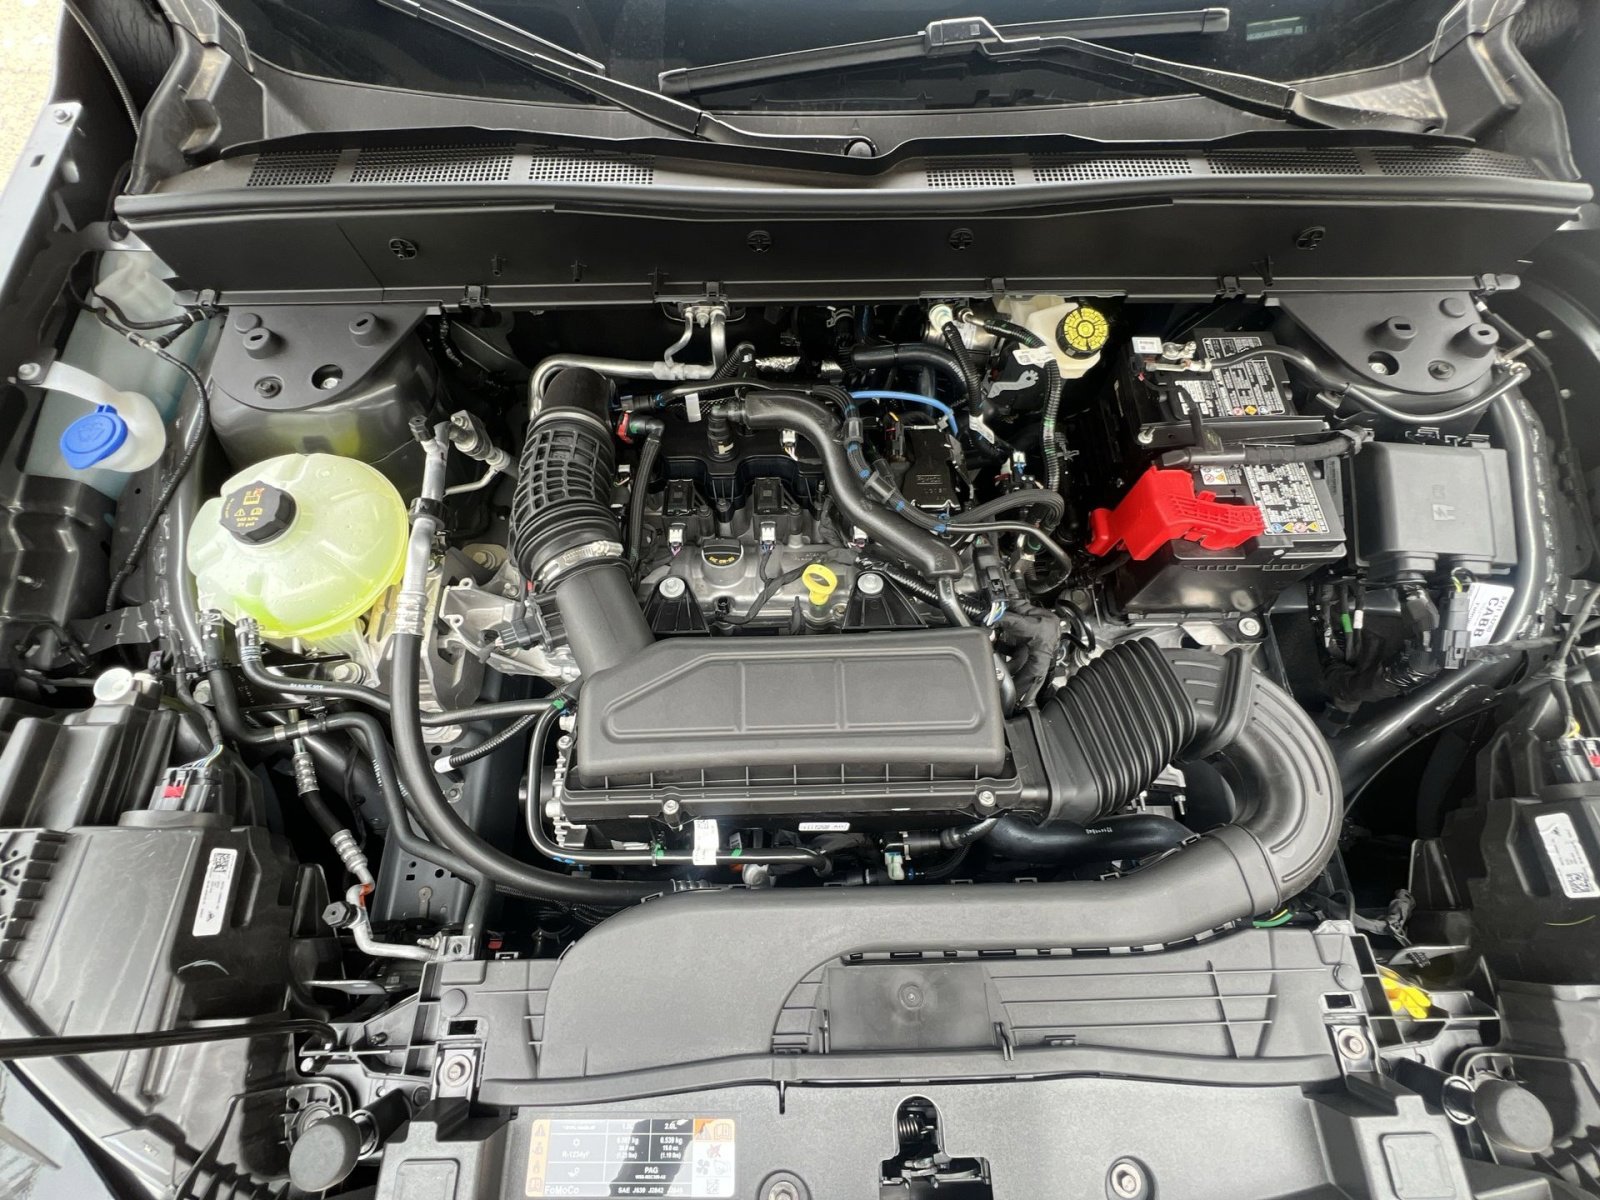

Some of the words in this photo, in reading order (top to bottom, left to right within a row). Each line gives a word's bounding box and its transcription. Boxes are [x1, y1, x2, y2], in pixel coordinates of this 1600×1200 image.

[1473, 597, 1500, 637] CABB
[644, 1166, 659, 1174] PAG
[544, 1185, 580, 1195] FoMoCo
[617, 1186, 631, 1194] SAE
